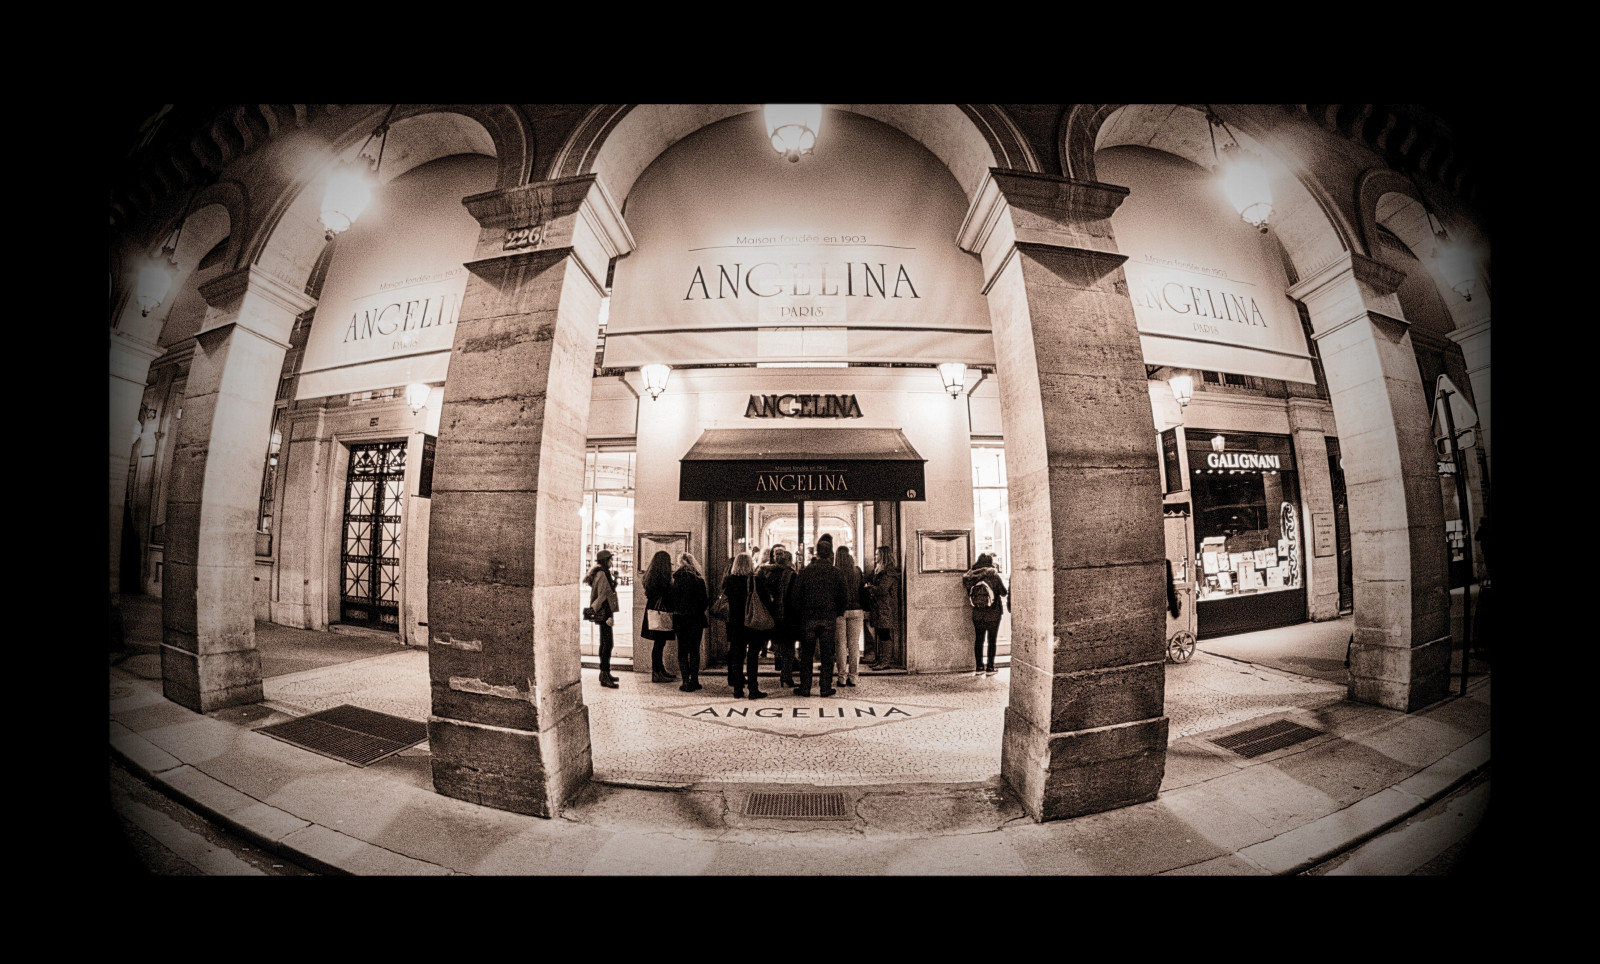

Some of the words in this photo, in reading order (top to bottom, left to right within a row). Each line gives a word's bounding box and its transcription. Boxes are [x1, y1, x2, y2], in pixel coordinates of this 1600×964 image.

[505, 228, 541, 248] 226
[736, 236, 776, 245] Maison
[841, 235, 867, 243] 1903
[683, 262, 921, 301] ANGELINA
[781, 306, 824, 317] PARIS
[743, 394, 864, 418] ANGELINA
[1207, 453, 1281, 469] GALIGNANI
[756, 474, 848, 491] ANGELINA
[691, 706, 912, 718] ANGELINA
